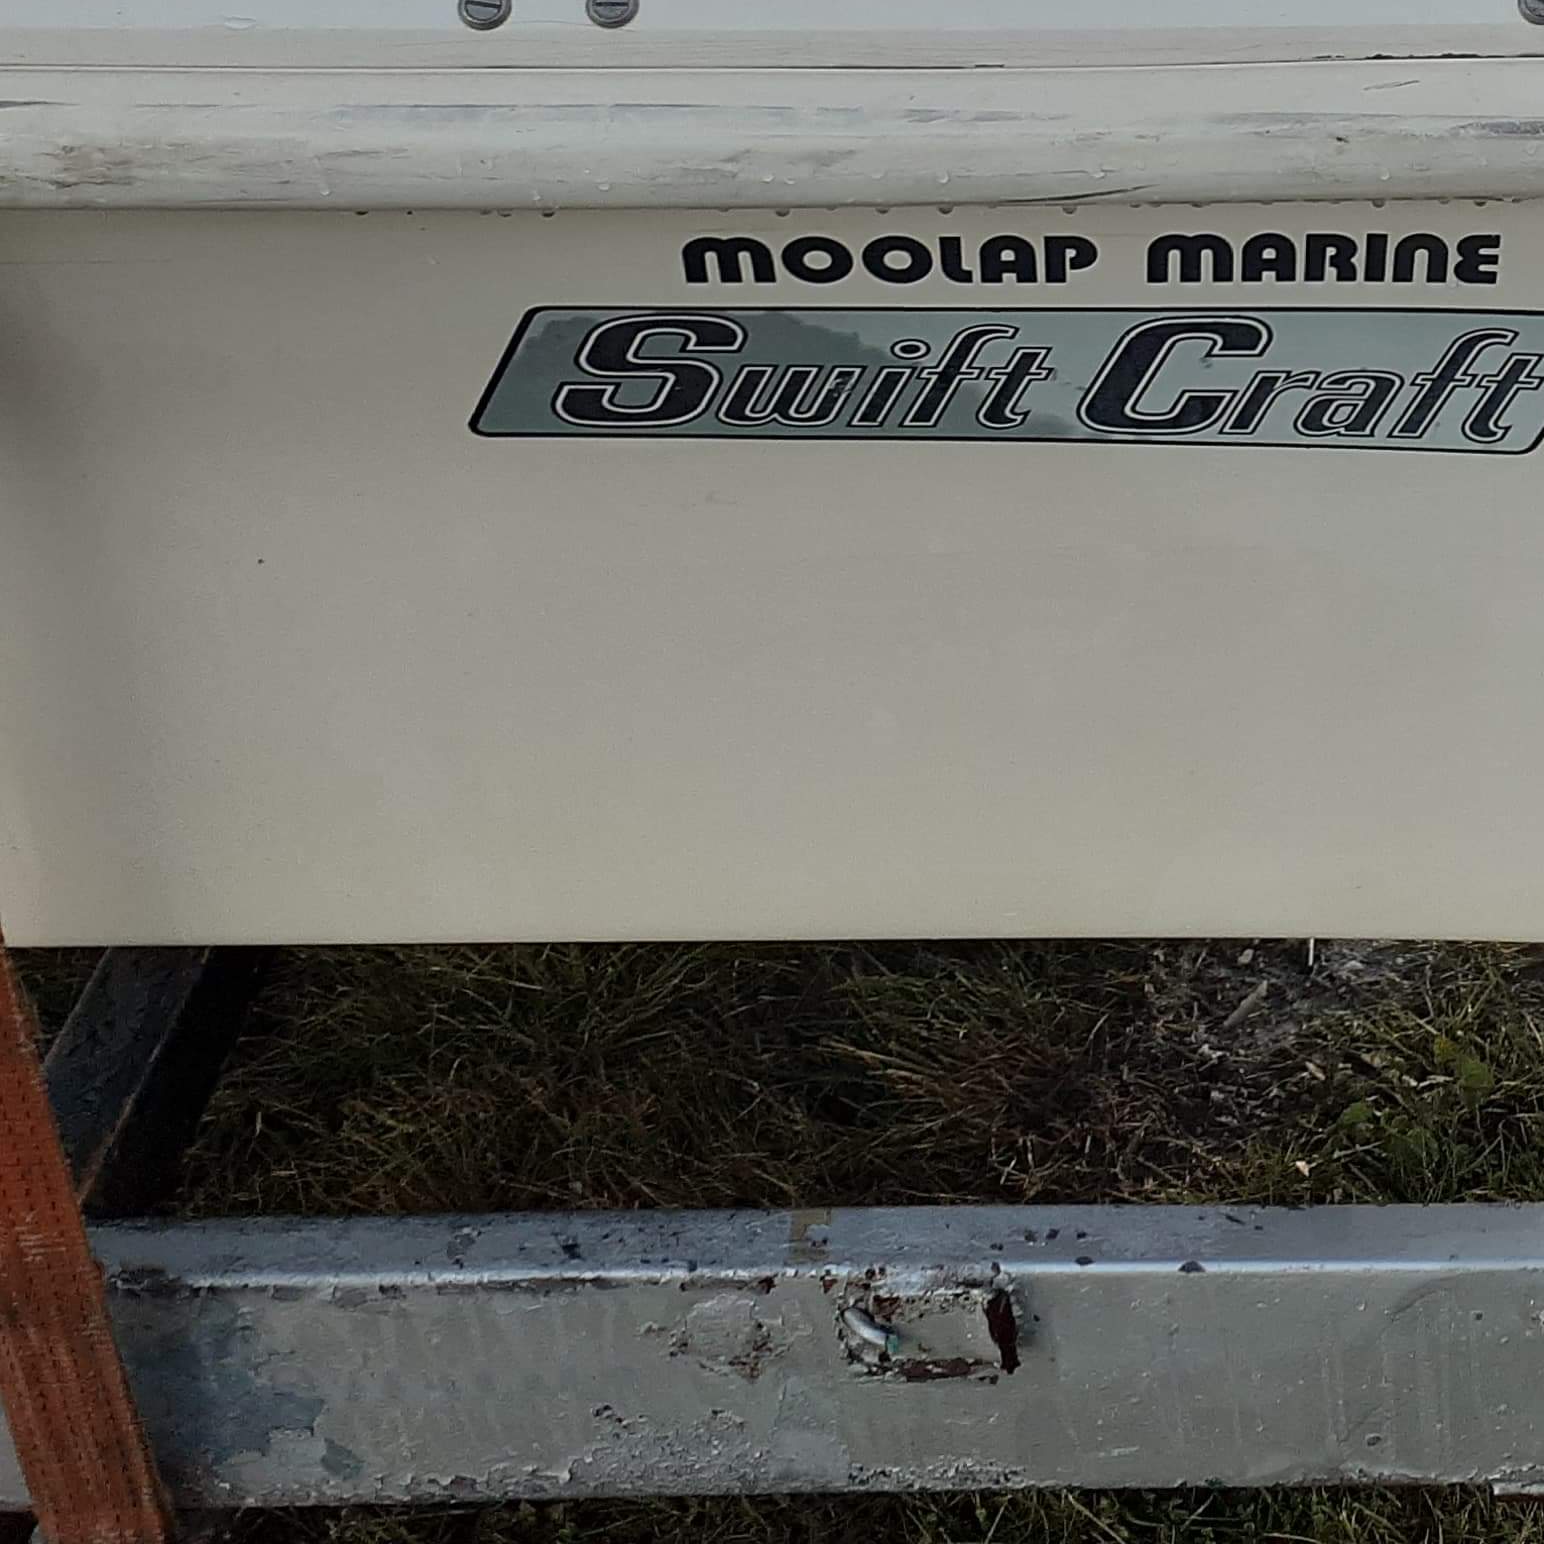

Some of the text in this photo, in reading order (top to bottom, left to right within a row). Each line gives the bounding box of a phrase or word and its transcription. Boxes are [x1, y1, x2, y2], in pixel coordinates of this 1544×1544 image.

[682, 232, 1502, 285] MOOLAP MARINE
[551, 312, 1056, 429] Swift
